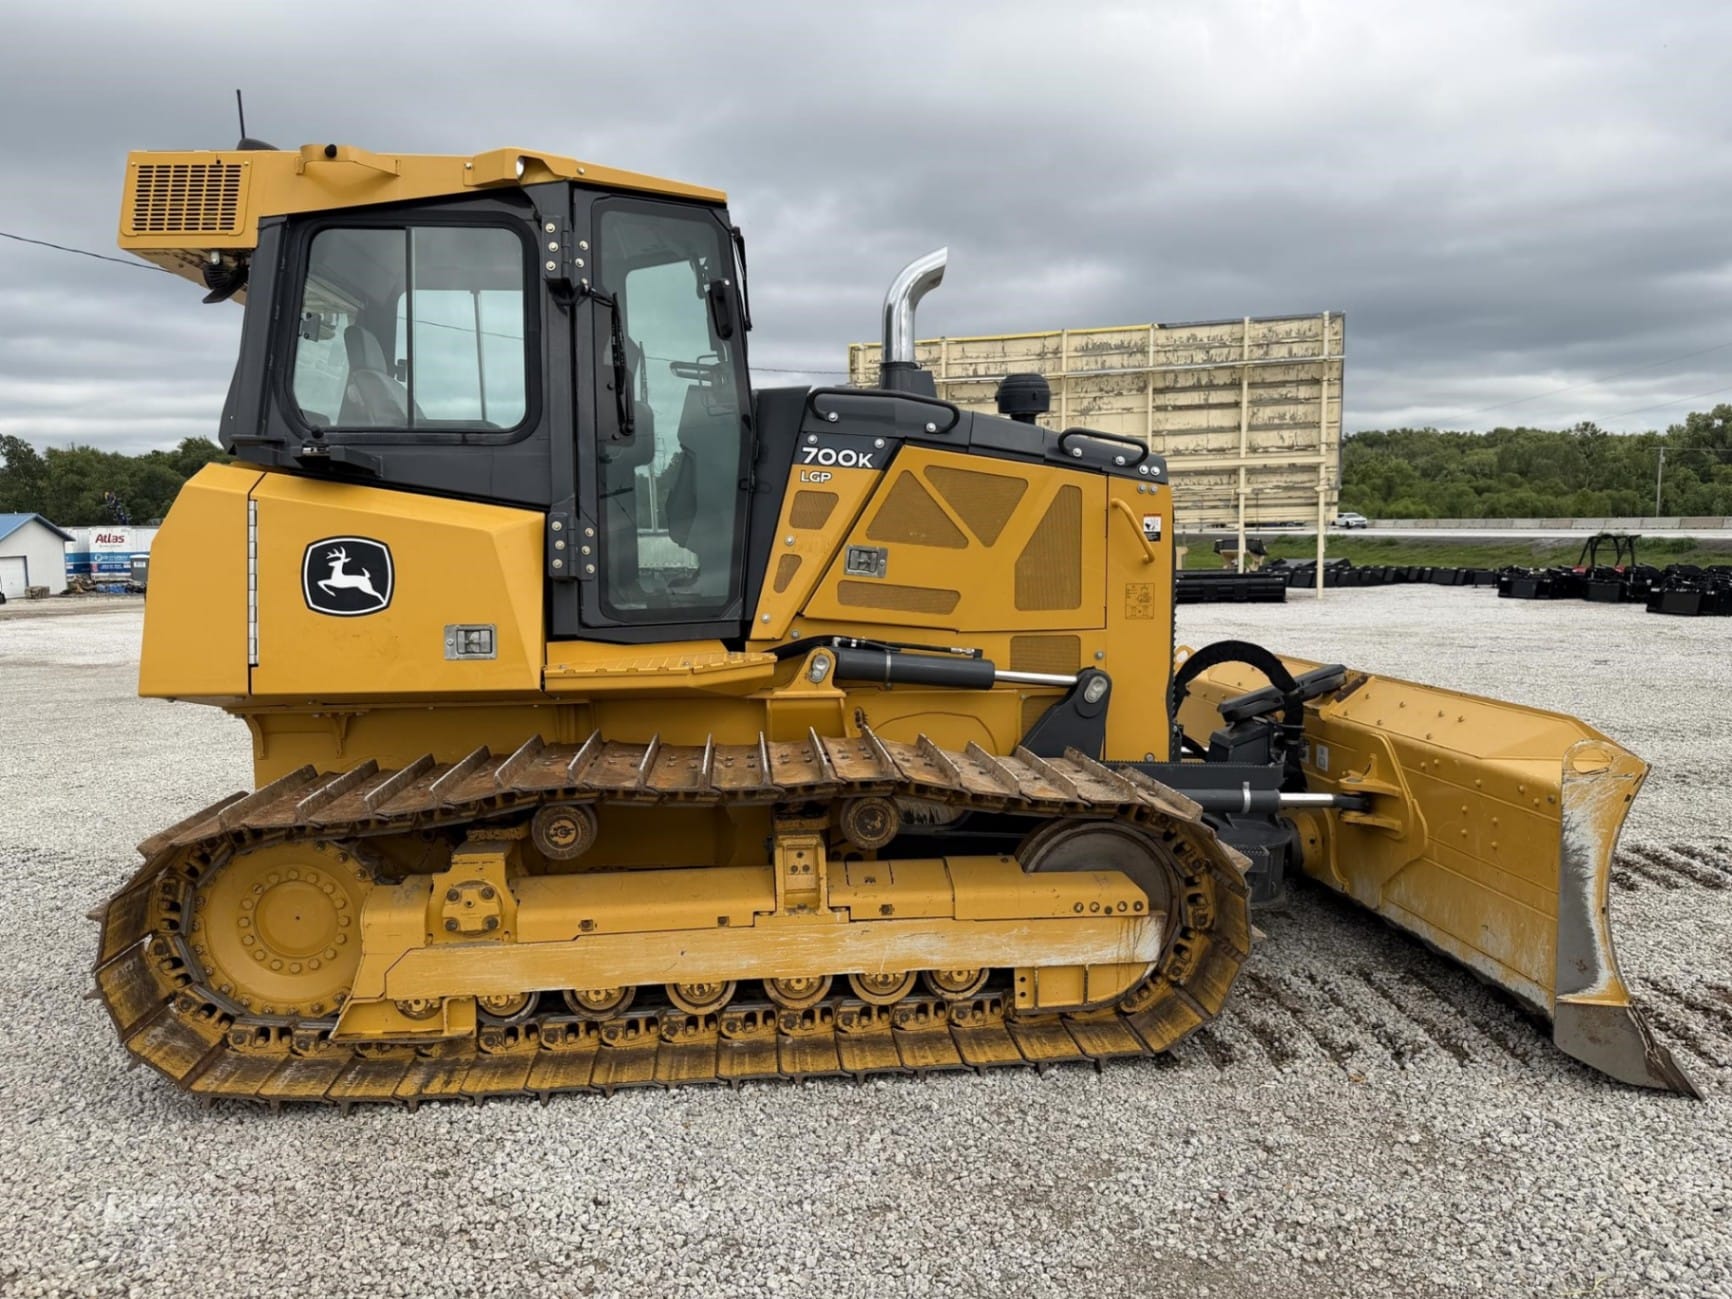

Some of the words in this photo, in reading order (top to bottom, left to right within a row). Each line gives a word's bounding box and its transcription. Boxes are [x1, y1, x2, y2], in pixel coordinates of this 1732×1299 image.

[802, 447, 873, 468] 700K
[801, 471, 832, 482] LGP
[95, 533, 125, 544] Atlas
